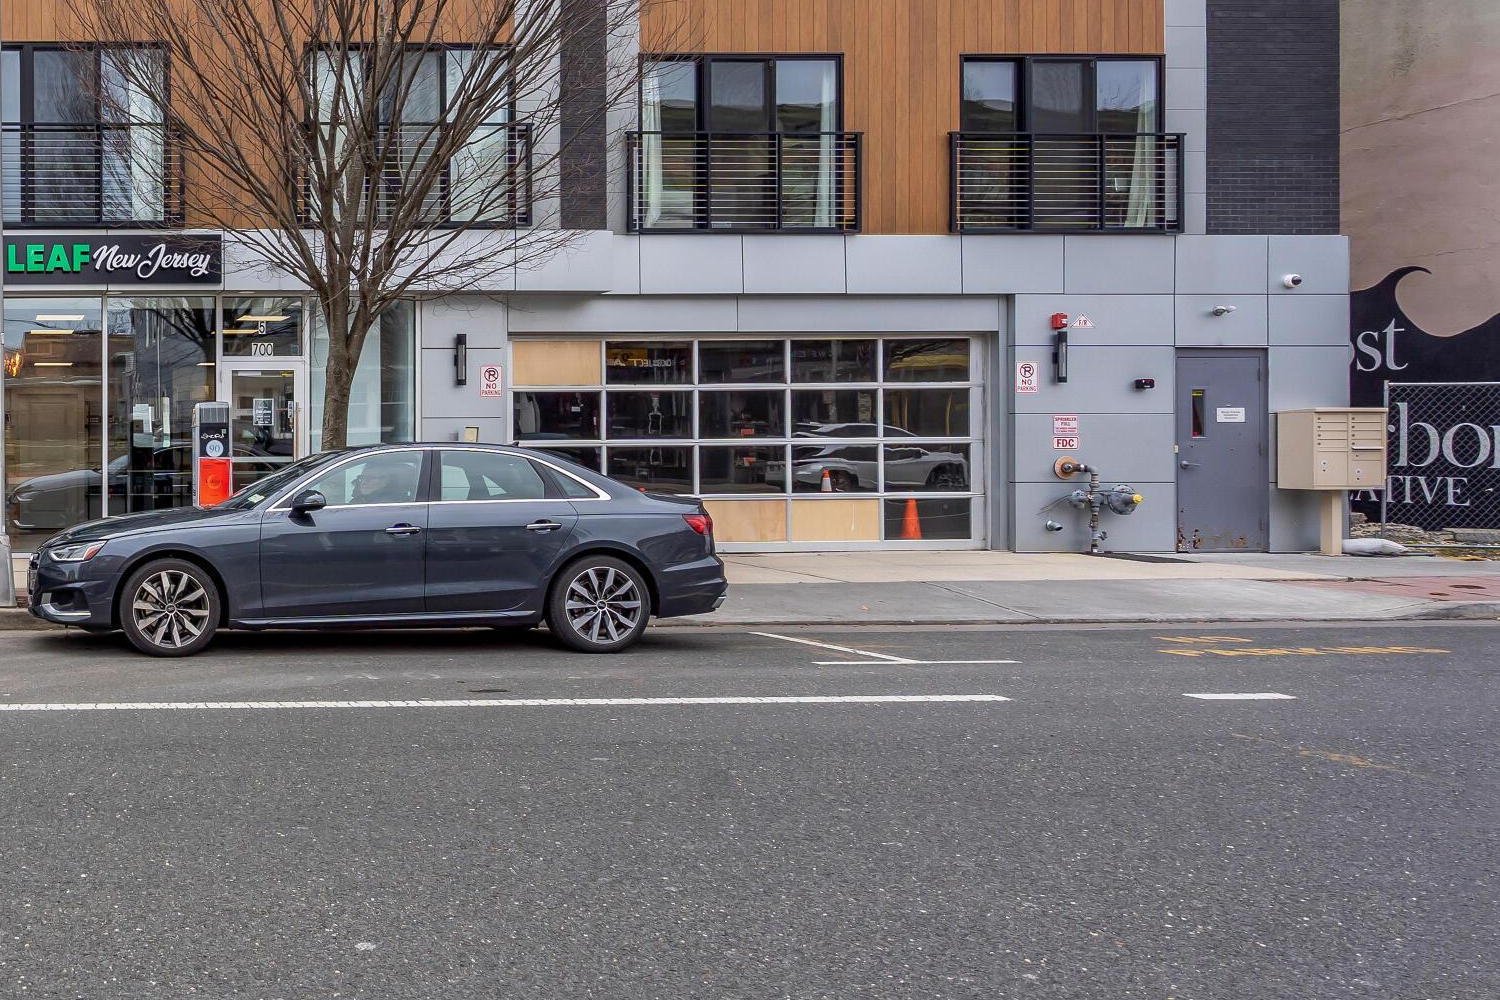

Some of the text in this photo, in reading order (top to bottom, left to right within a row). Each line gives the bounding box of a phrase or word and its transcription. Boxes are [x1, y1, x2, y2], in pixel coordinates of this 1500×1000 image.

[8, 244, 91, 273] LEAF
[92, 245, 141, 271] New
[137, 244, 211, 278] Jersey
[259, 321, 266, 334] 5
[252, 343, 273, 356] 700
[1350, 318, 1408, 372] st
[1056, 439, 1075, 447] FDC
[1388, 402, 1500, 469] bo
[209, 444, 220, 454] 90
[1351, 475, 1470, 506] TIVE
